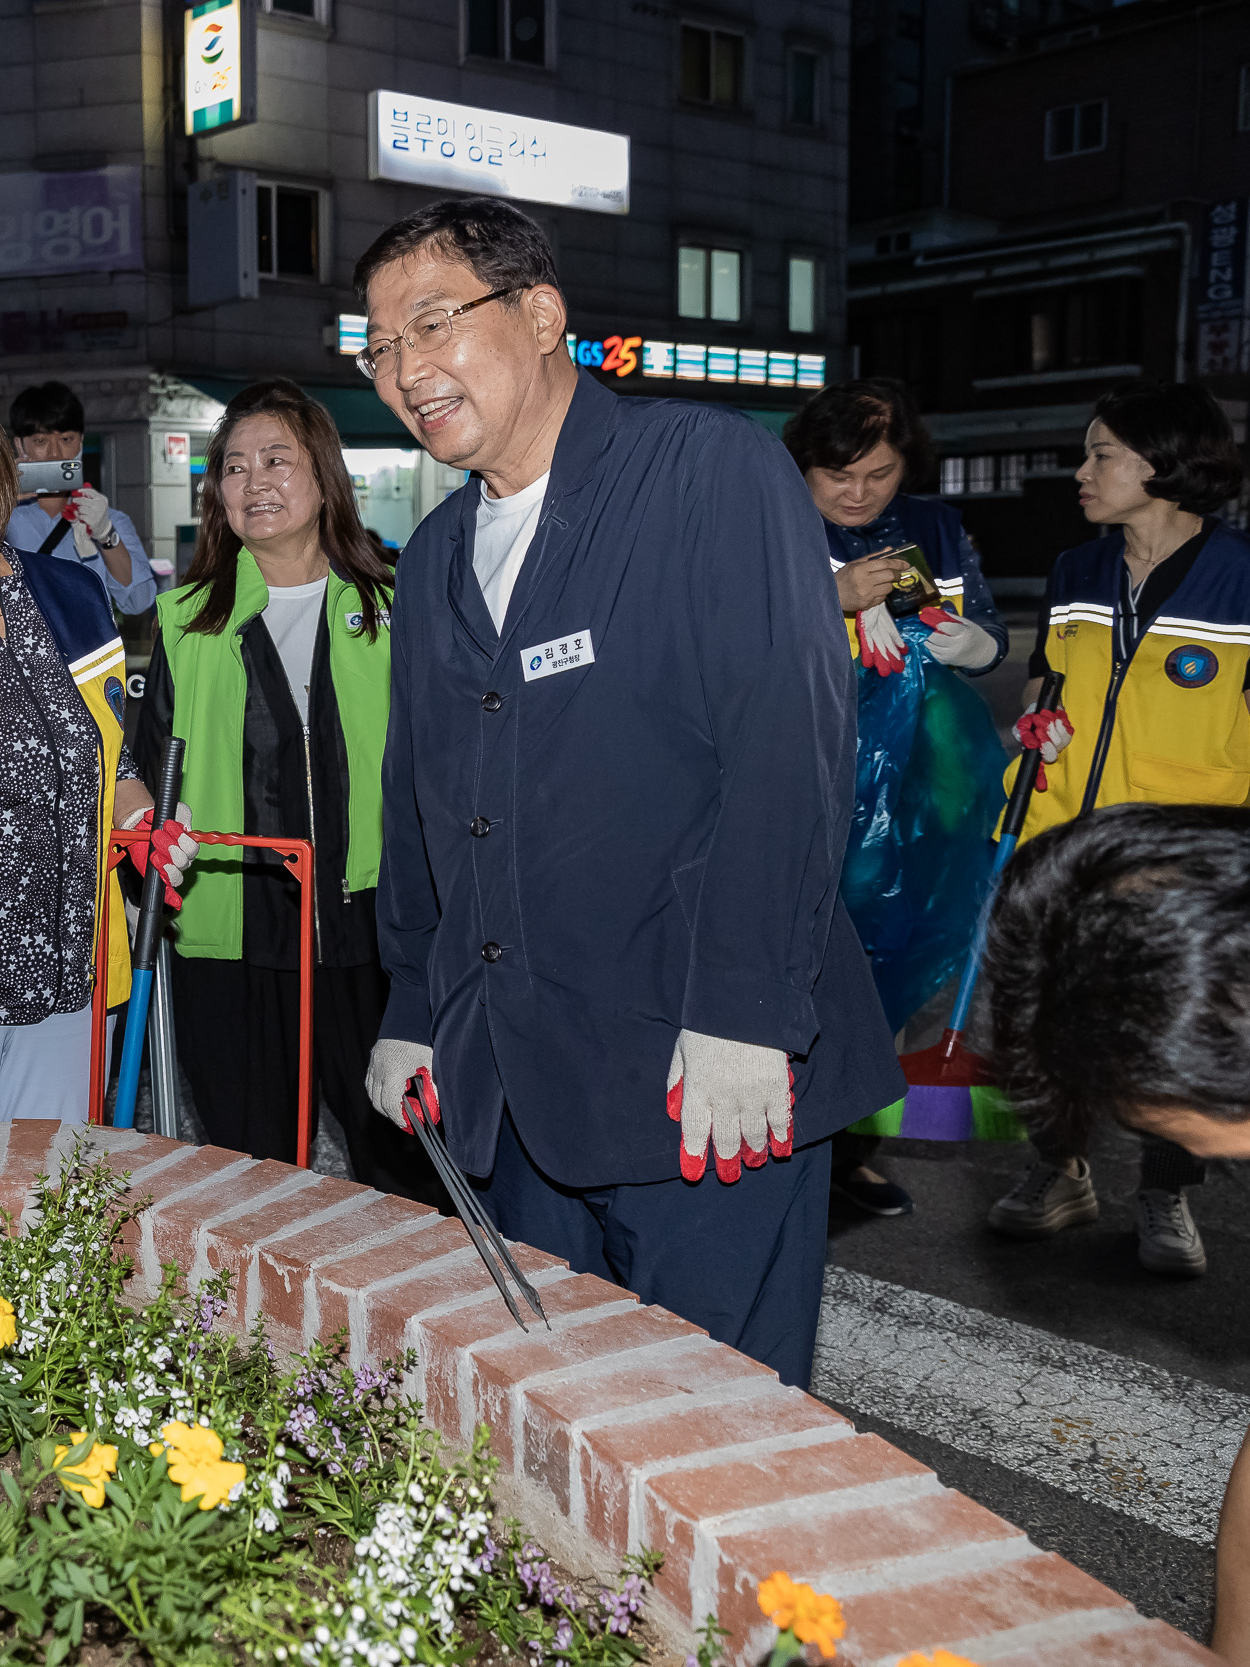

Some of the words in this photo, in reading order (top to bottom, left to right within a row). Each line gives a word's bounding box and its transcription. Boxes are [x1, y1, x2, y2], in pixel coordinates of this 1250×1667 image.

[390, 108, 456, 159] 블루밍
[576, 335, 642, 378] GS25
[551, 654, 581, 669] 광진구청장
